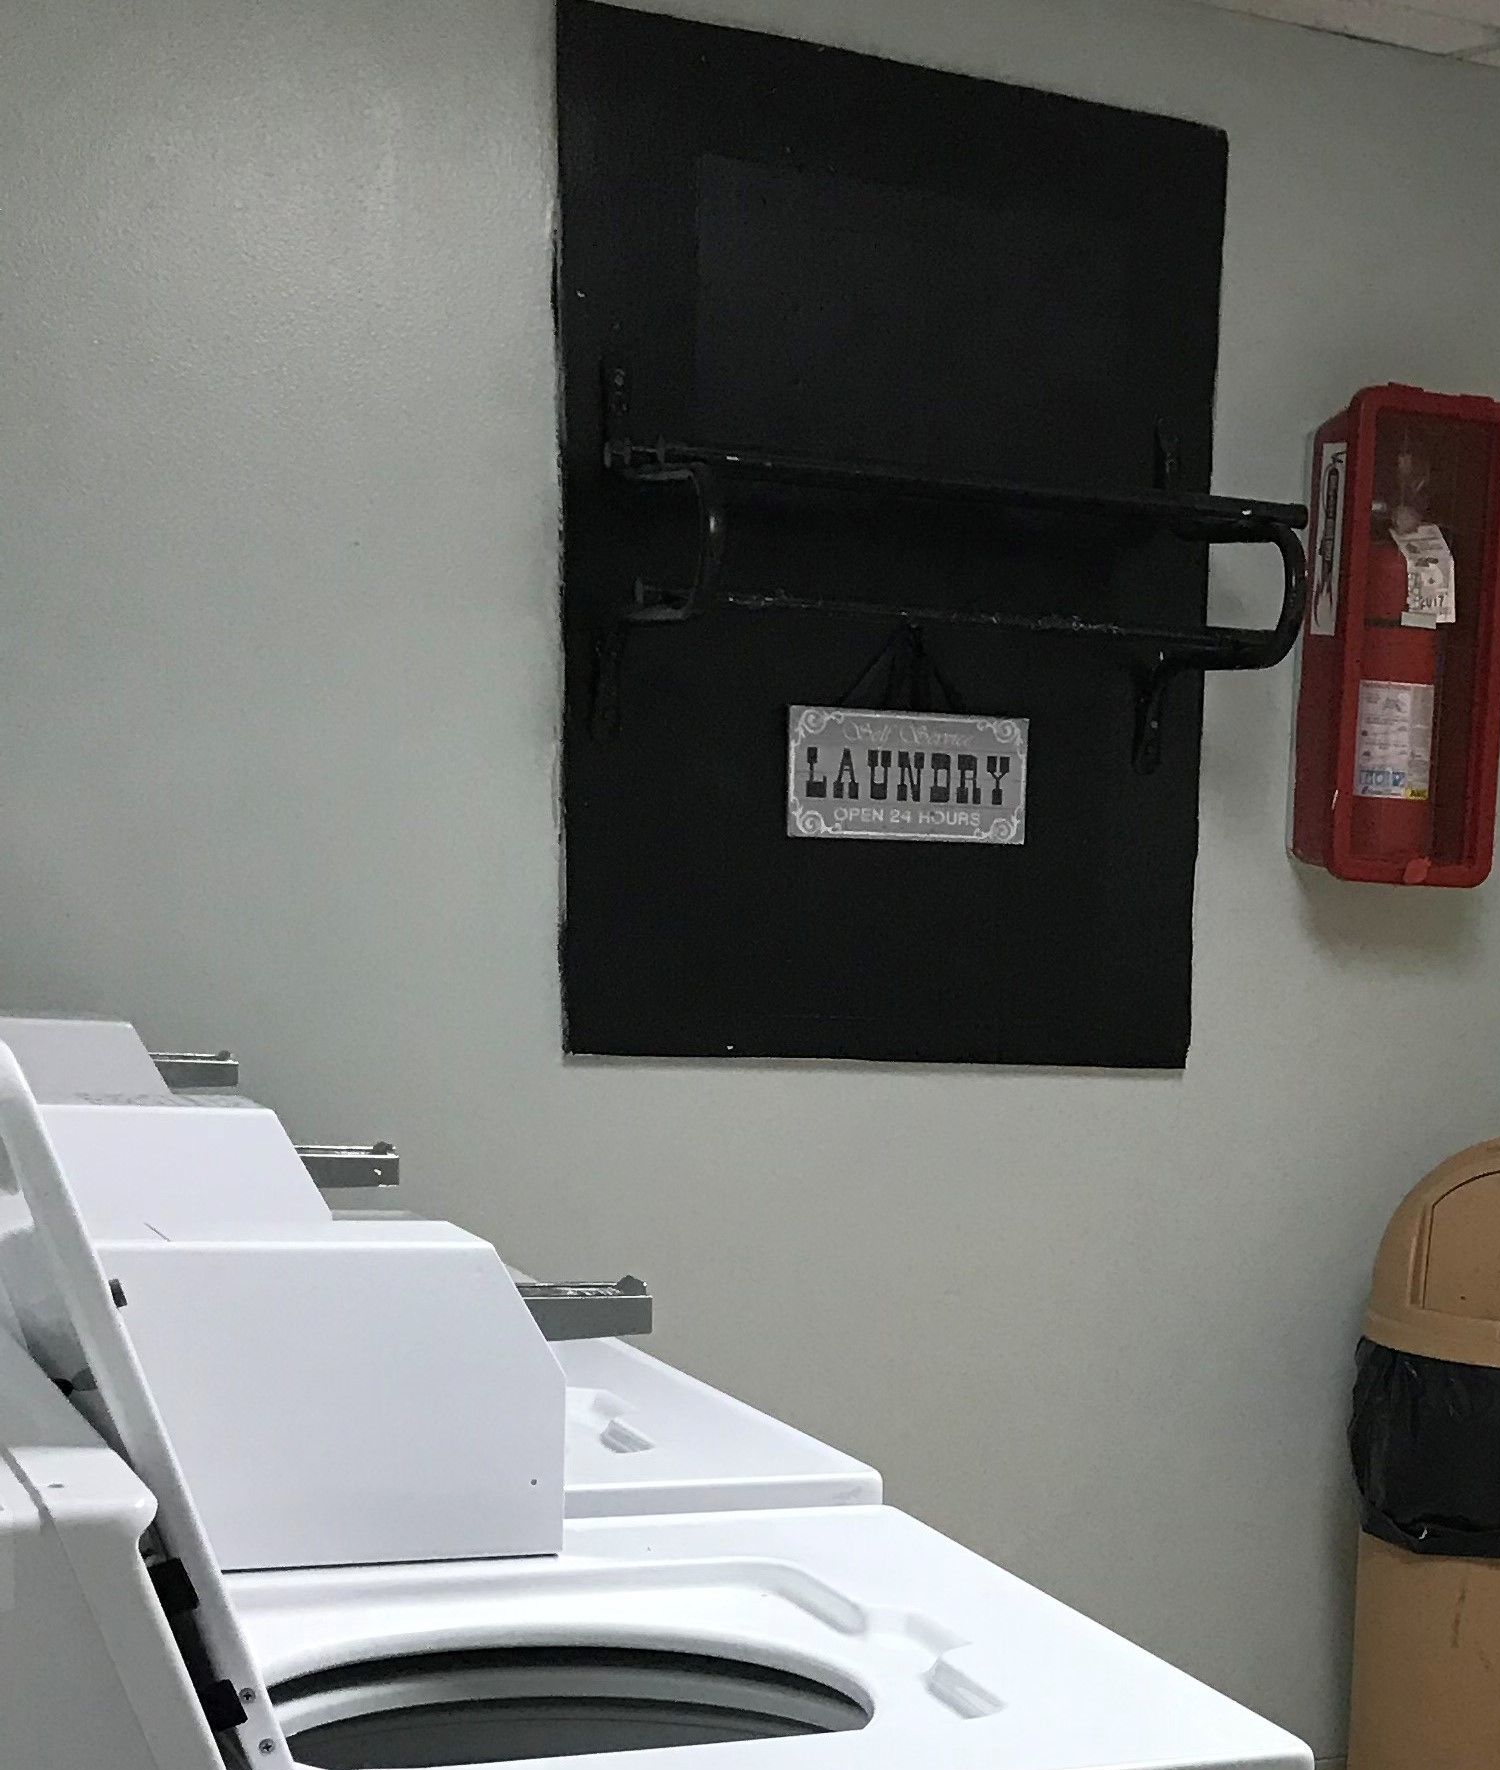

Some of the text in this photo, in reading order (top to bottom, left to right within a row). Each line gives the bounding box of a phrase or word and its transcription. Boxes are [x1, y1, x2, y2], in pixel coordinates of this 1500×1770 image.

[805, 746, 1010, 805] LAUNDRY
[833, 807, 981, 826] OPEN 24 HOURS
